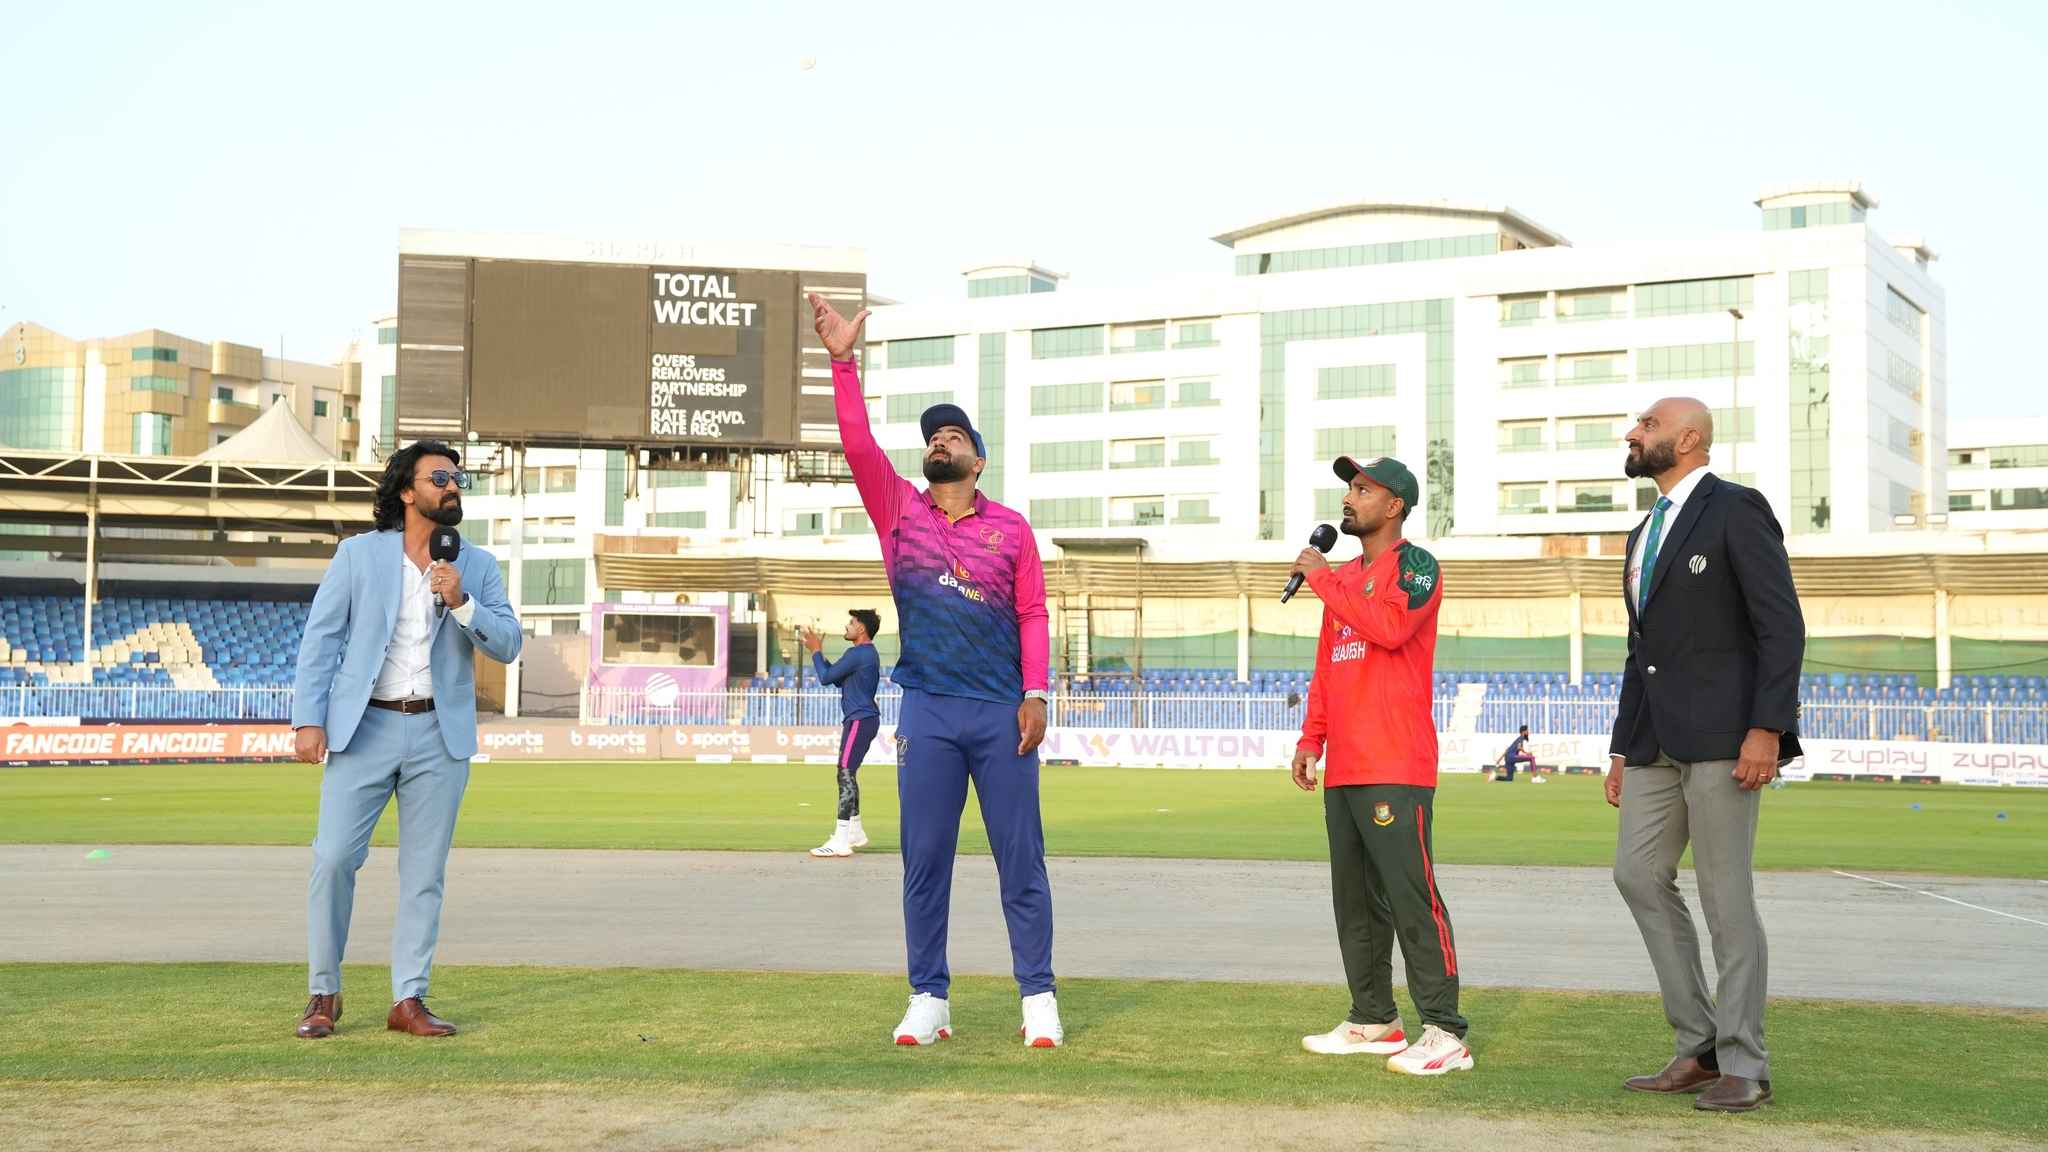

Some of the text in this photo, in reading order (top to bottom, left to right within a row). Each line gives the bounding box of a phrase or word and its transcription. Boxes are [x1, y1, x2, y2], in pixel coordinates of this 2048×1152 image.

[654, 273, 737, 299] TOTAL
[653, 300, 757, 326] WICKET
[652, 353, 696, 368] OVERS
[651, 366, 726, 382] REM.OVERS
[651, 381, 748, 397] PARTNERSHIP
[651, 394, 676, 408] D/L
[651, 408, 745, 425] RATE ACHVD.
[650, 420, 722, 438] RATE REQ.
[6, 732, 297, 755] FANCODE FANCODE FANC
[483, 729, 544, 749] sports
[570, 730, 583, 746] b
[587, 730, 647, 750] sports
[675, 729, 688, 745] b
[692, 729, 750, 749] sports
[776, 730, 843, 749] b sport
[1130, 734, 1265, 758] WALTON
[1830, 748, 1928, 774] zuplay
